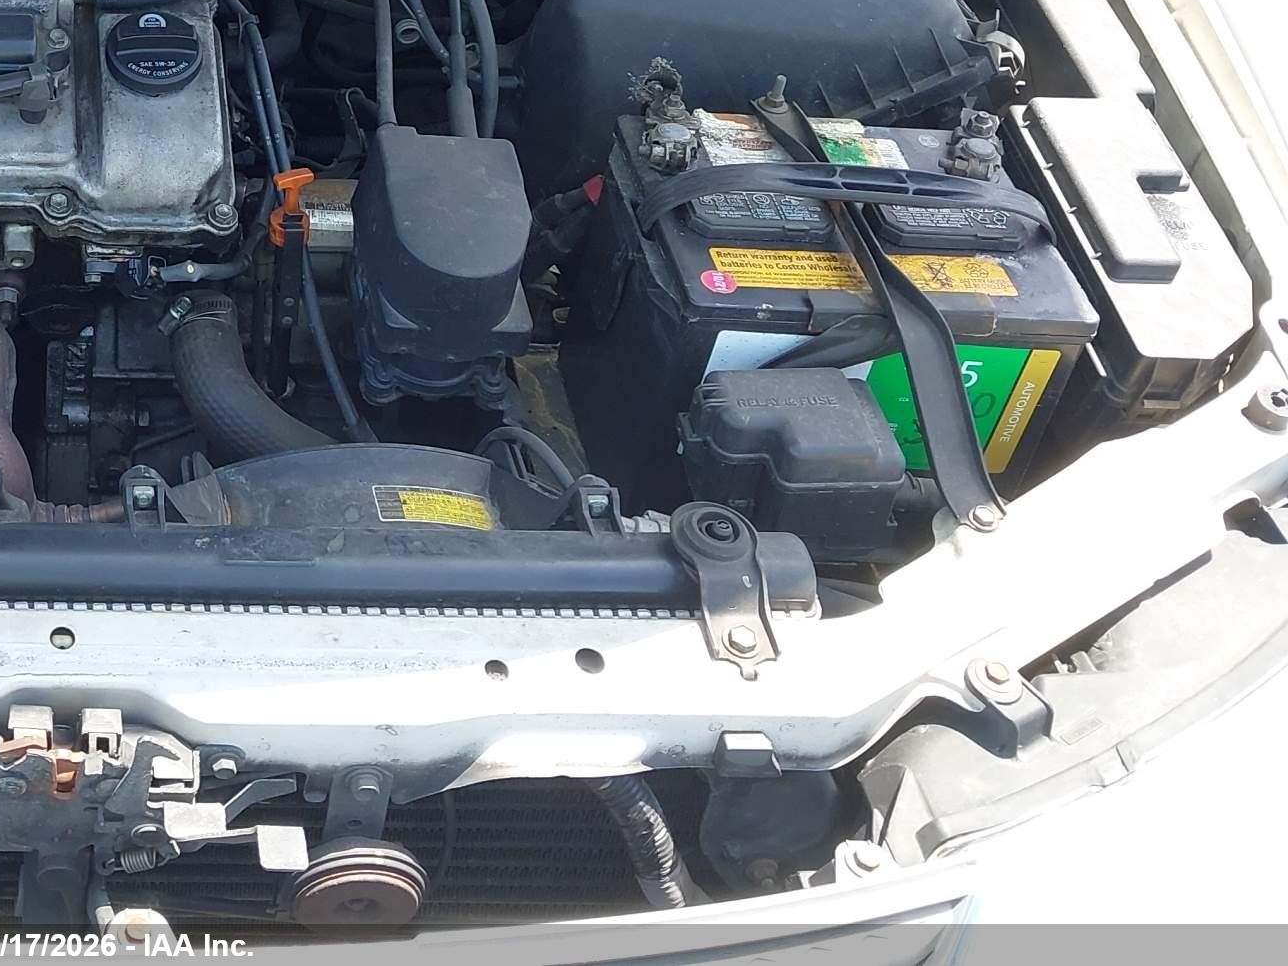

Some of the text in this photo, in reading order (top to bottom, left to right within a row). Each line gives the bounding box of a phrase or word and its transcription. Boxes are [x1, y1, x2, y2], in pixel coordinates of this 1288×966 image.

[715, 250, 838, 263] Return warranty and used
[720, 260, 762, 270] batteries
[764, 262, 774, 270] to
[775, 262, 806, 271] Costco
[801, 395, 841, 408] FUSE
[999, 381, 1036, 444] AUTOMOTIVE
